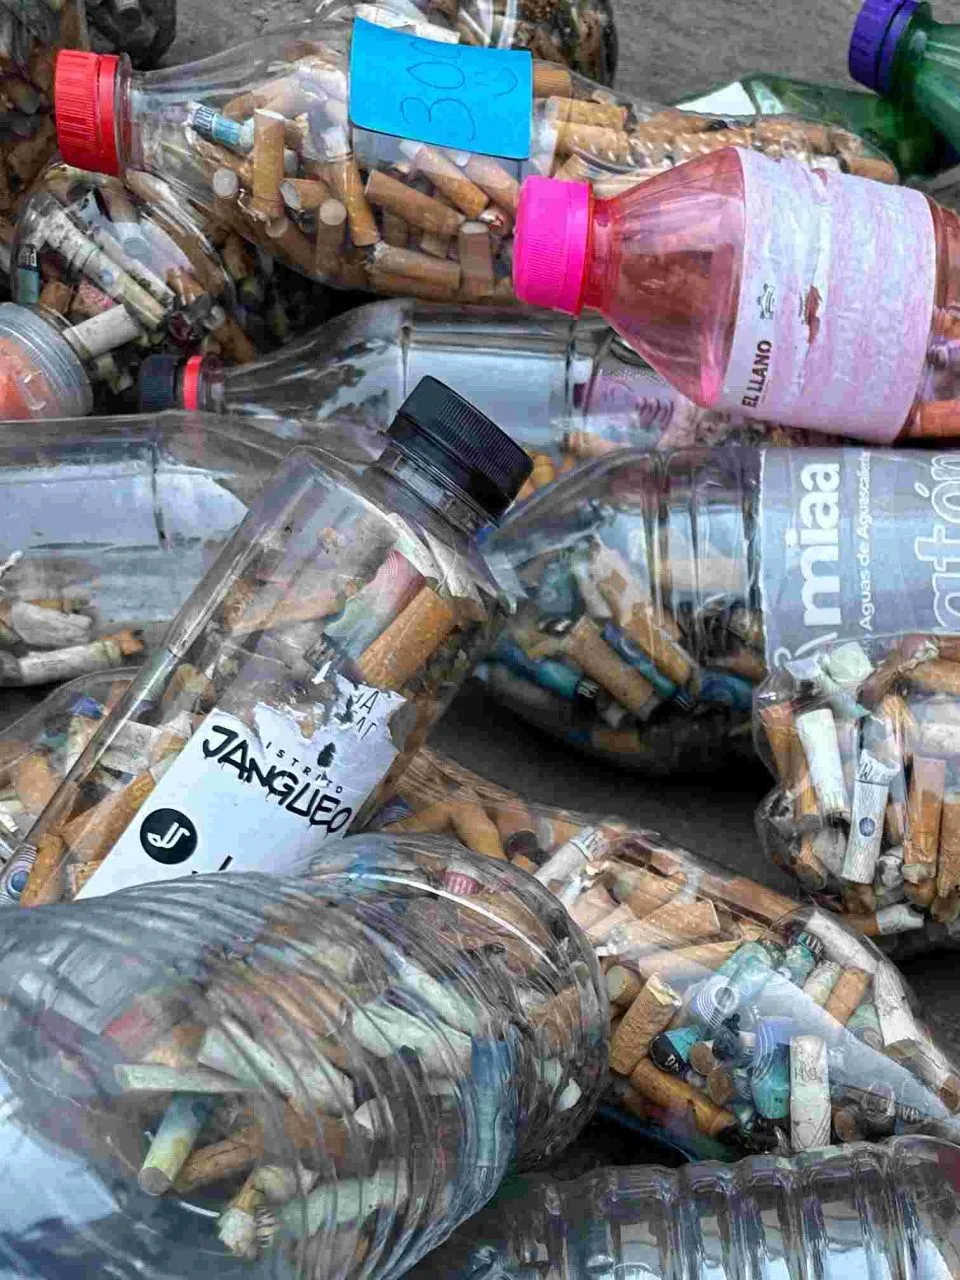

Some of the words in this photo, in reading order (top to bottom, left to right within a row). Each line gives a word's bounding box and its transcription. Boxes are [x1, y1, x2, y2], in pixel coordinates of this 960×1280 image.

[746, 340, 772, 393] LLANO
[741, 395, 760, 409] EL
[784, 463, 842, 627] miaa
[857, 543, 870, 567] de
[859, 569, 875, 631] Aguas
[203, 725, 352, 837] JANGUEO
